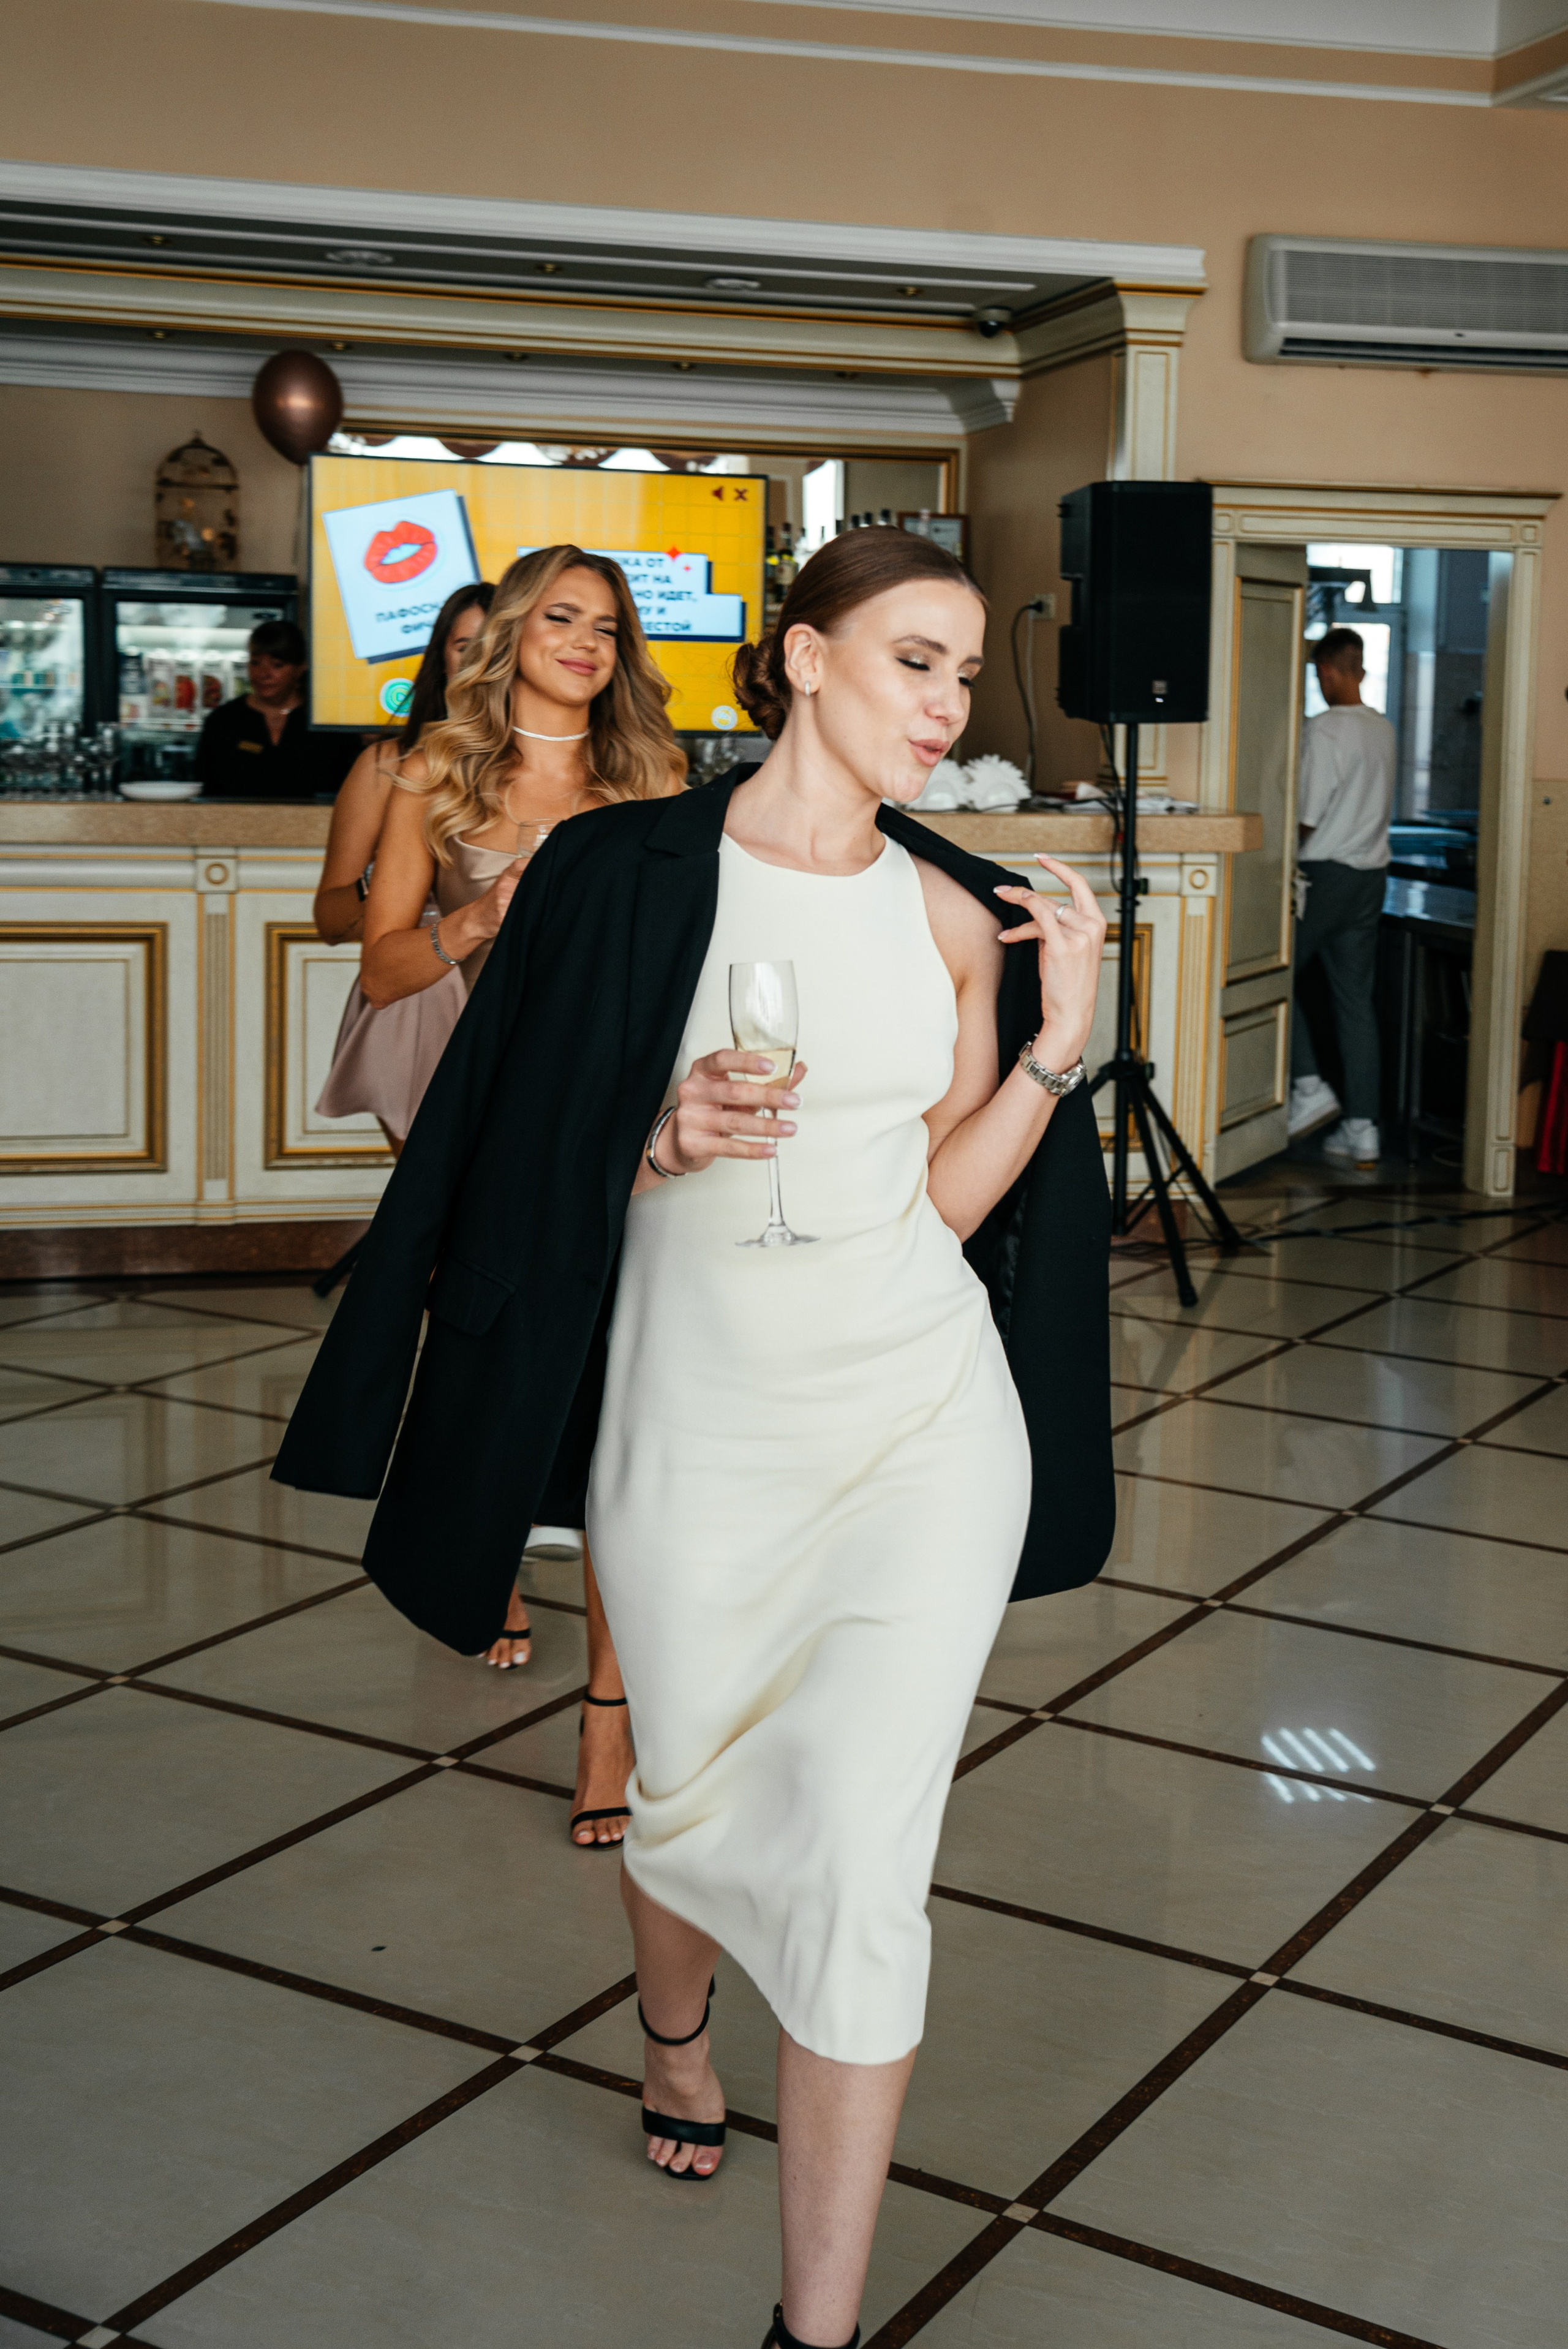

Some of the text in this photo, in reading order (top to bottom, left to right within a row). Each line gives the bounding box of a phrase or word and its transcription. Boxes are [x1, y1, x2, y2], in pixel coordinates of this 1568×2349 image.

[646, 558, 665, 568] ОТ
[653, 575, 672, 584] НА
[631, 590, 652, 600] НО
[375, 602, 443, 624] ПАФОСН
[642, 620, 692, 632] ЕСТОЙ
